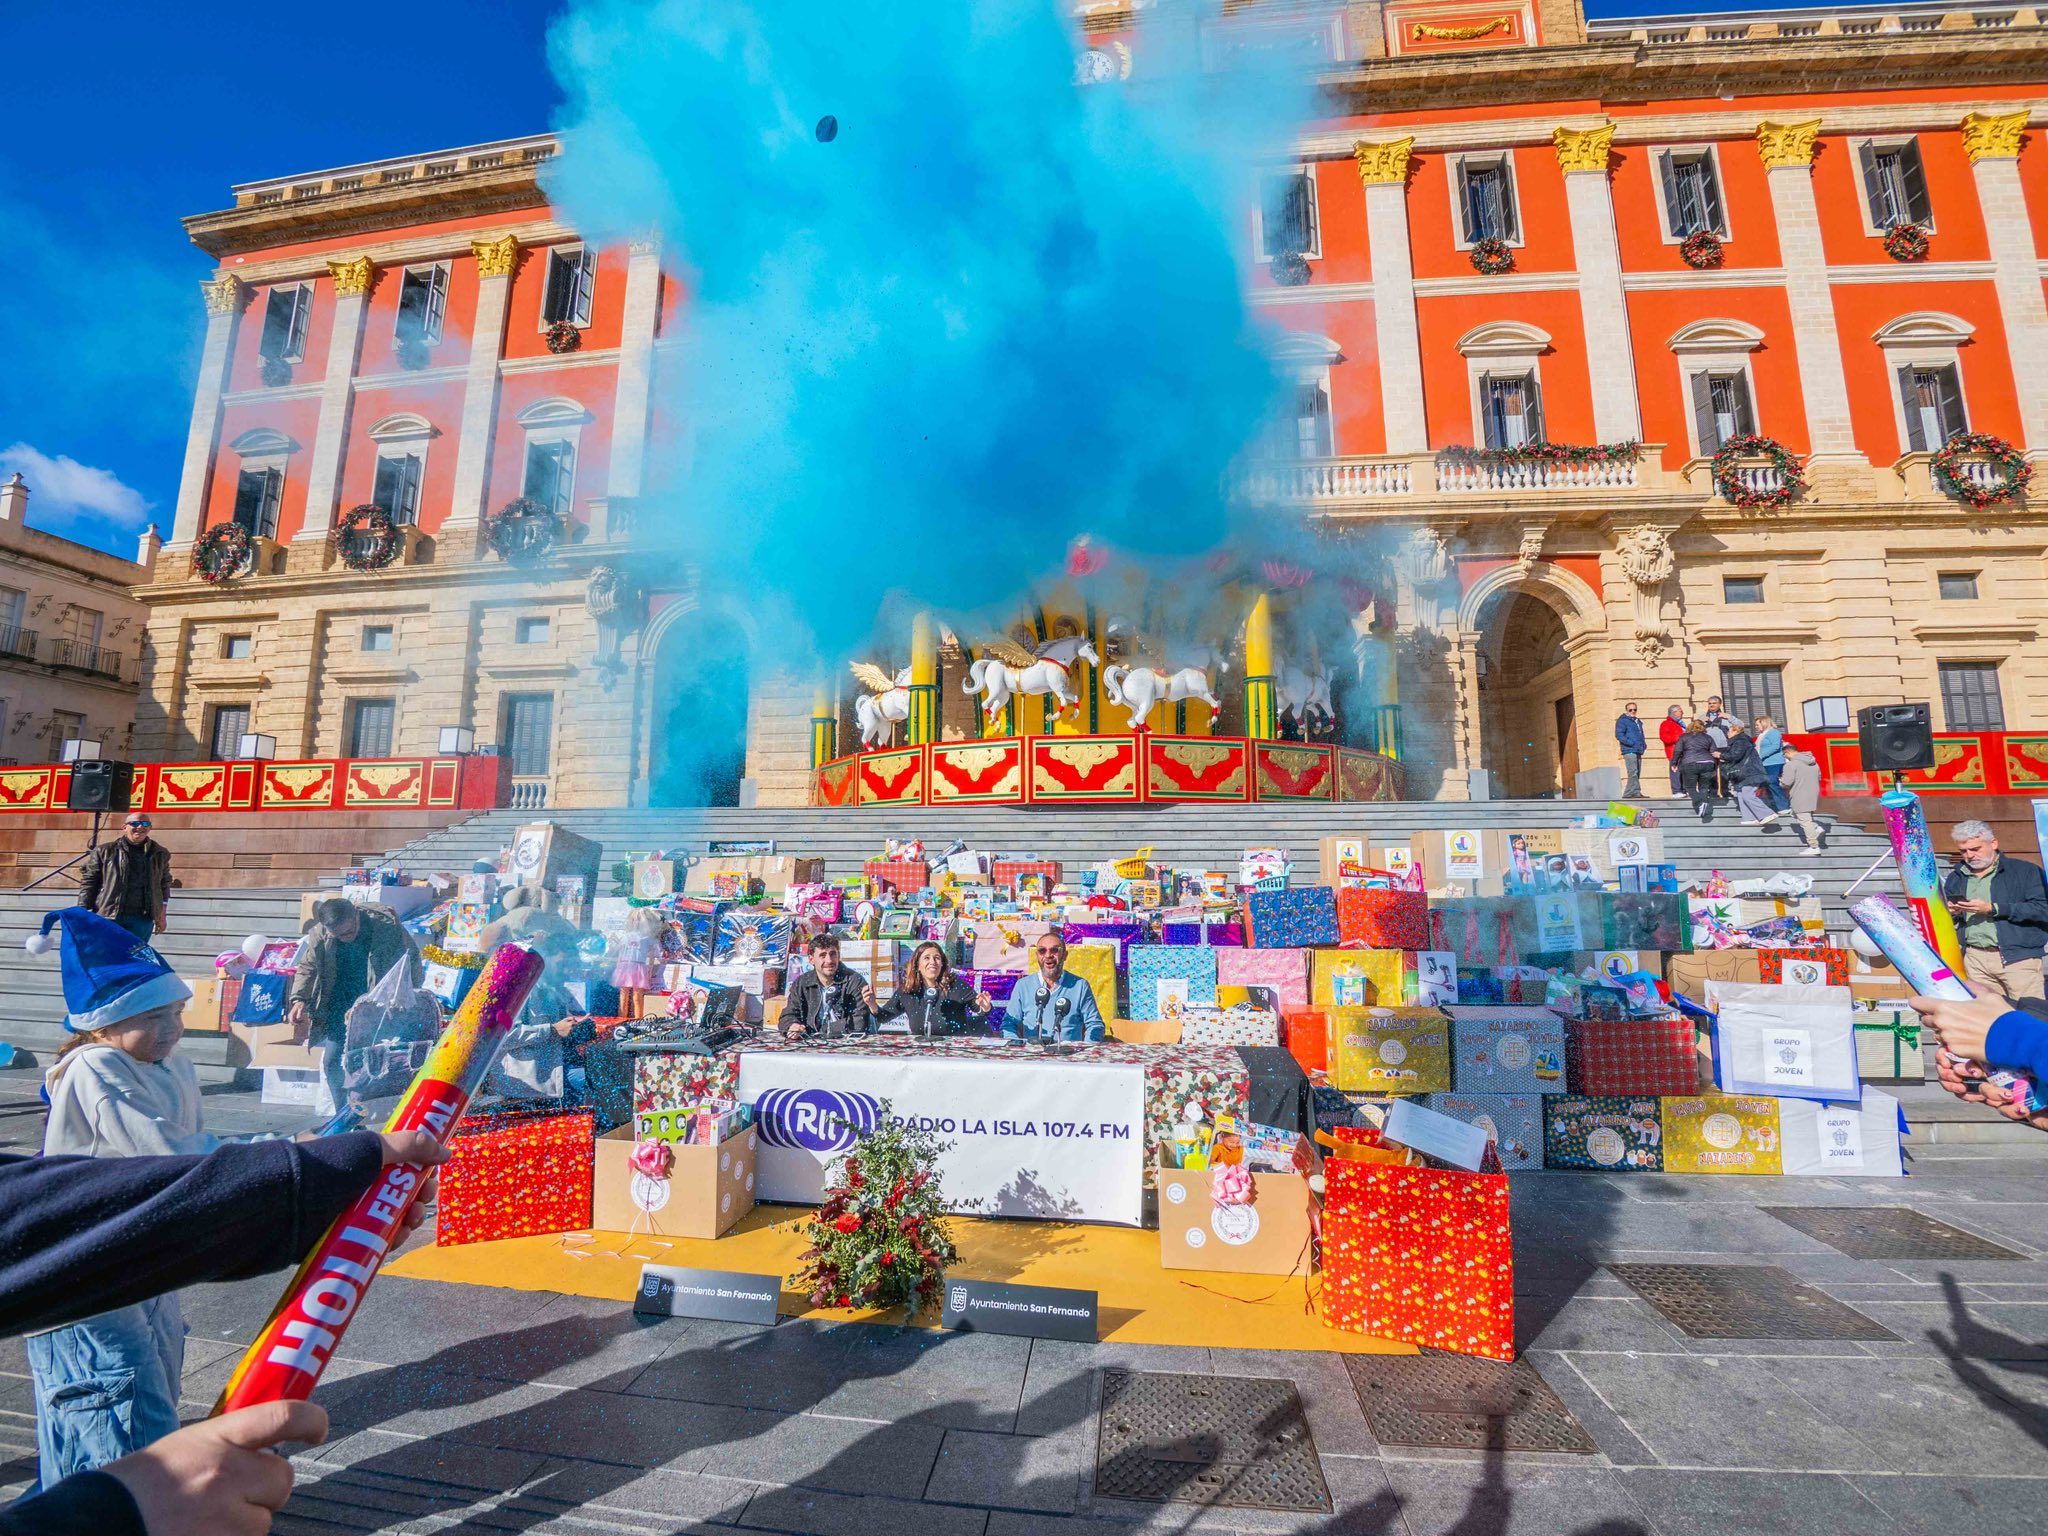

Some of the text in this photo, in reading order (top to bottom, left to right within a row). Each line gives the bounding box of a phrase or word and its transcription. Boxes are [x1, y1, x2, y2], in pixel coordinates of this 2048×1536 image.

[1774, 1038, 1801, 1047] GRUPO
[1774, 1066, 1804, 1076] JOVEN
[961, 1118, 988, 1135] LA
[993, 1119, 1038, 1137] ISLA
[1043, 1121, 1094, 1138] 107.4
[1099, 1123, 1130, 1140] FM
[1698, 1152, 1755, 1166] NAZARENO
[1829, 1149, 1855, 1157] JOVEN
[661, 1283, 716, 1297] Ayuntamiento
[716, 1288, 733, 1298] San
[733, 1291, 772, 1301] Fernando
[267, 1225, 389, 1378] HOLI
[969, 1298, 1090, 1317] Ayuntamiento San Fernando
